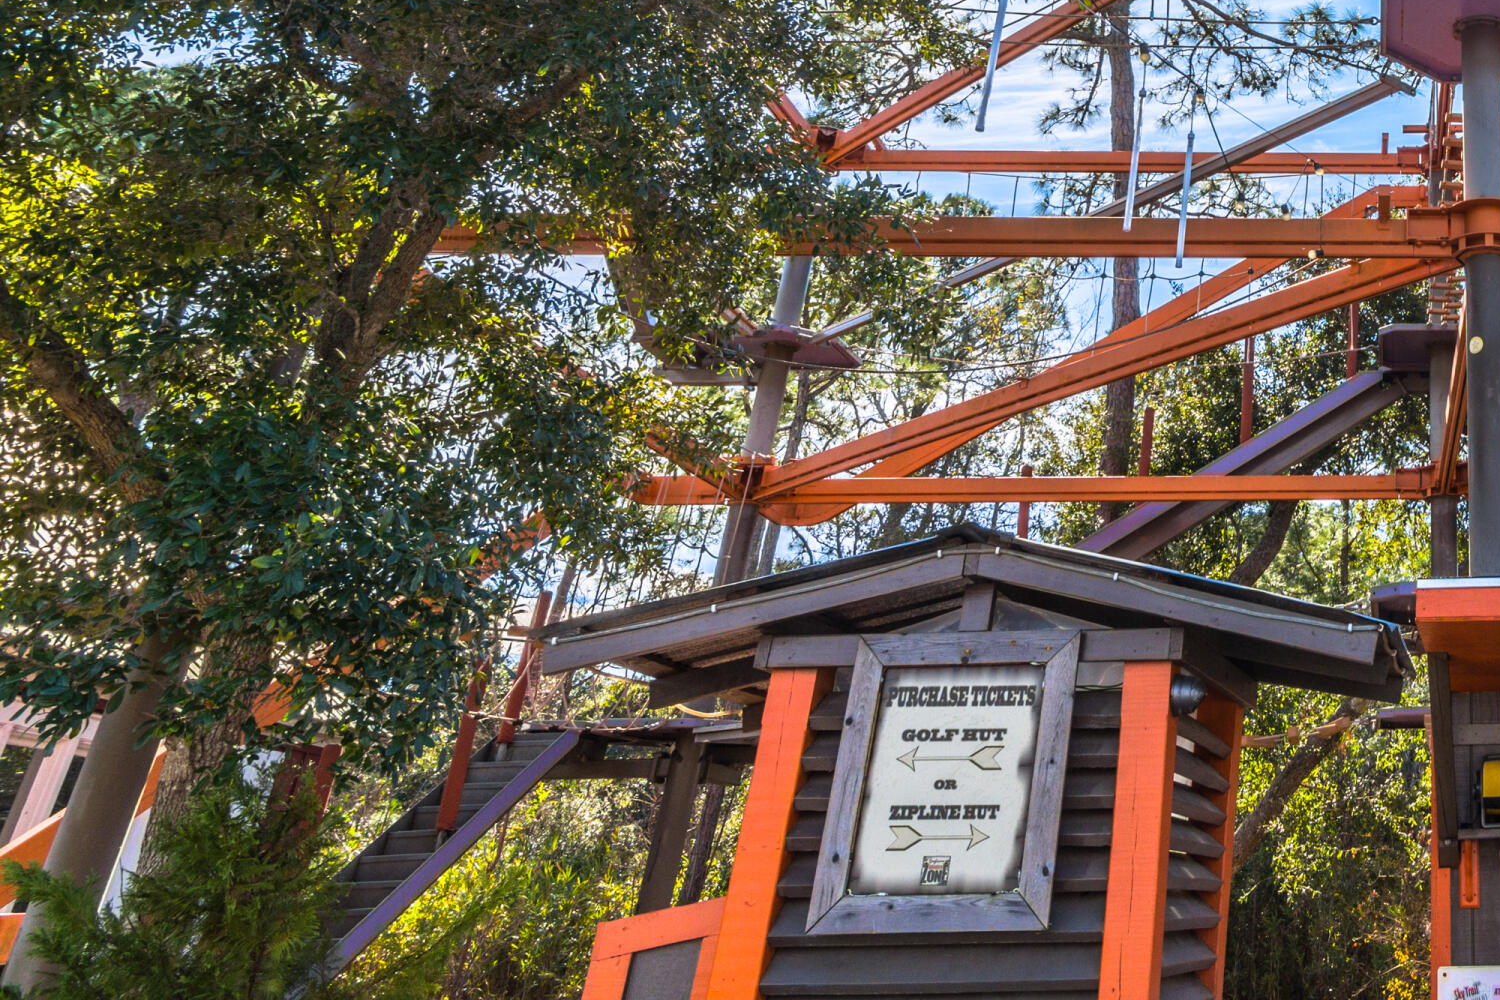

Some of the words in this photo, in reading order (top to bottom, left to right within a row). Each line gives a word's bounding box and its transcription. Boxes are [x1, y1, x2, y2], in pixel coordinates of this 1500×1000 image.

[886, 686, 969, 707] PURCHASE
[970, 685, 1036, 706] TICKETS
[902, 729, 959, 742] GOLF
[961, 728, 1007, 742] HUT
[934, 779, 957, 790] OR
[889, 805, 961, 820] ZIPLINE
[962, 804, 1000, 820] HUT
